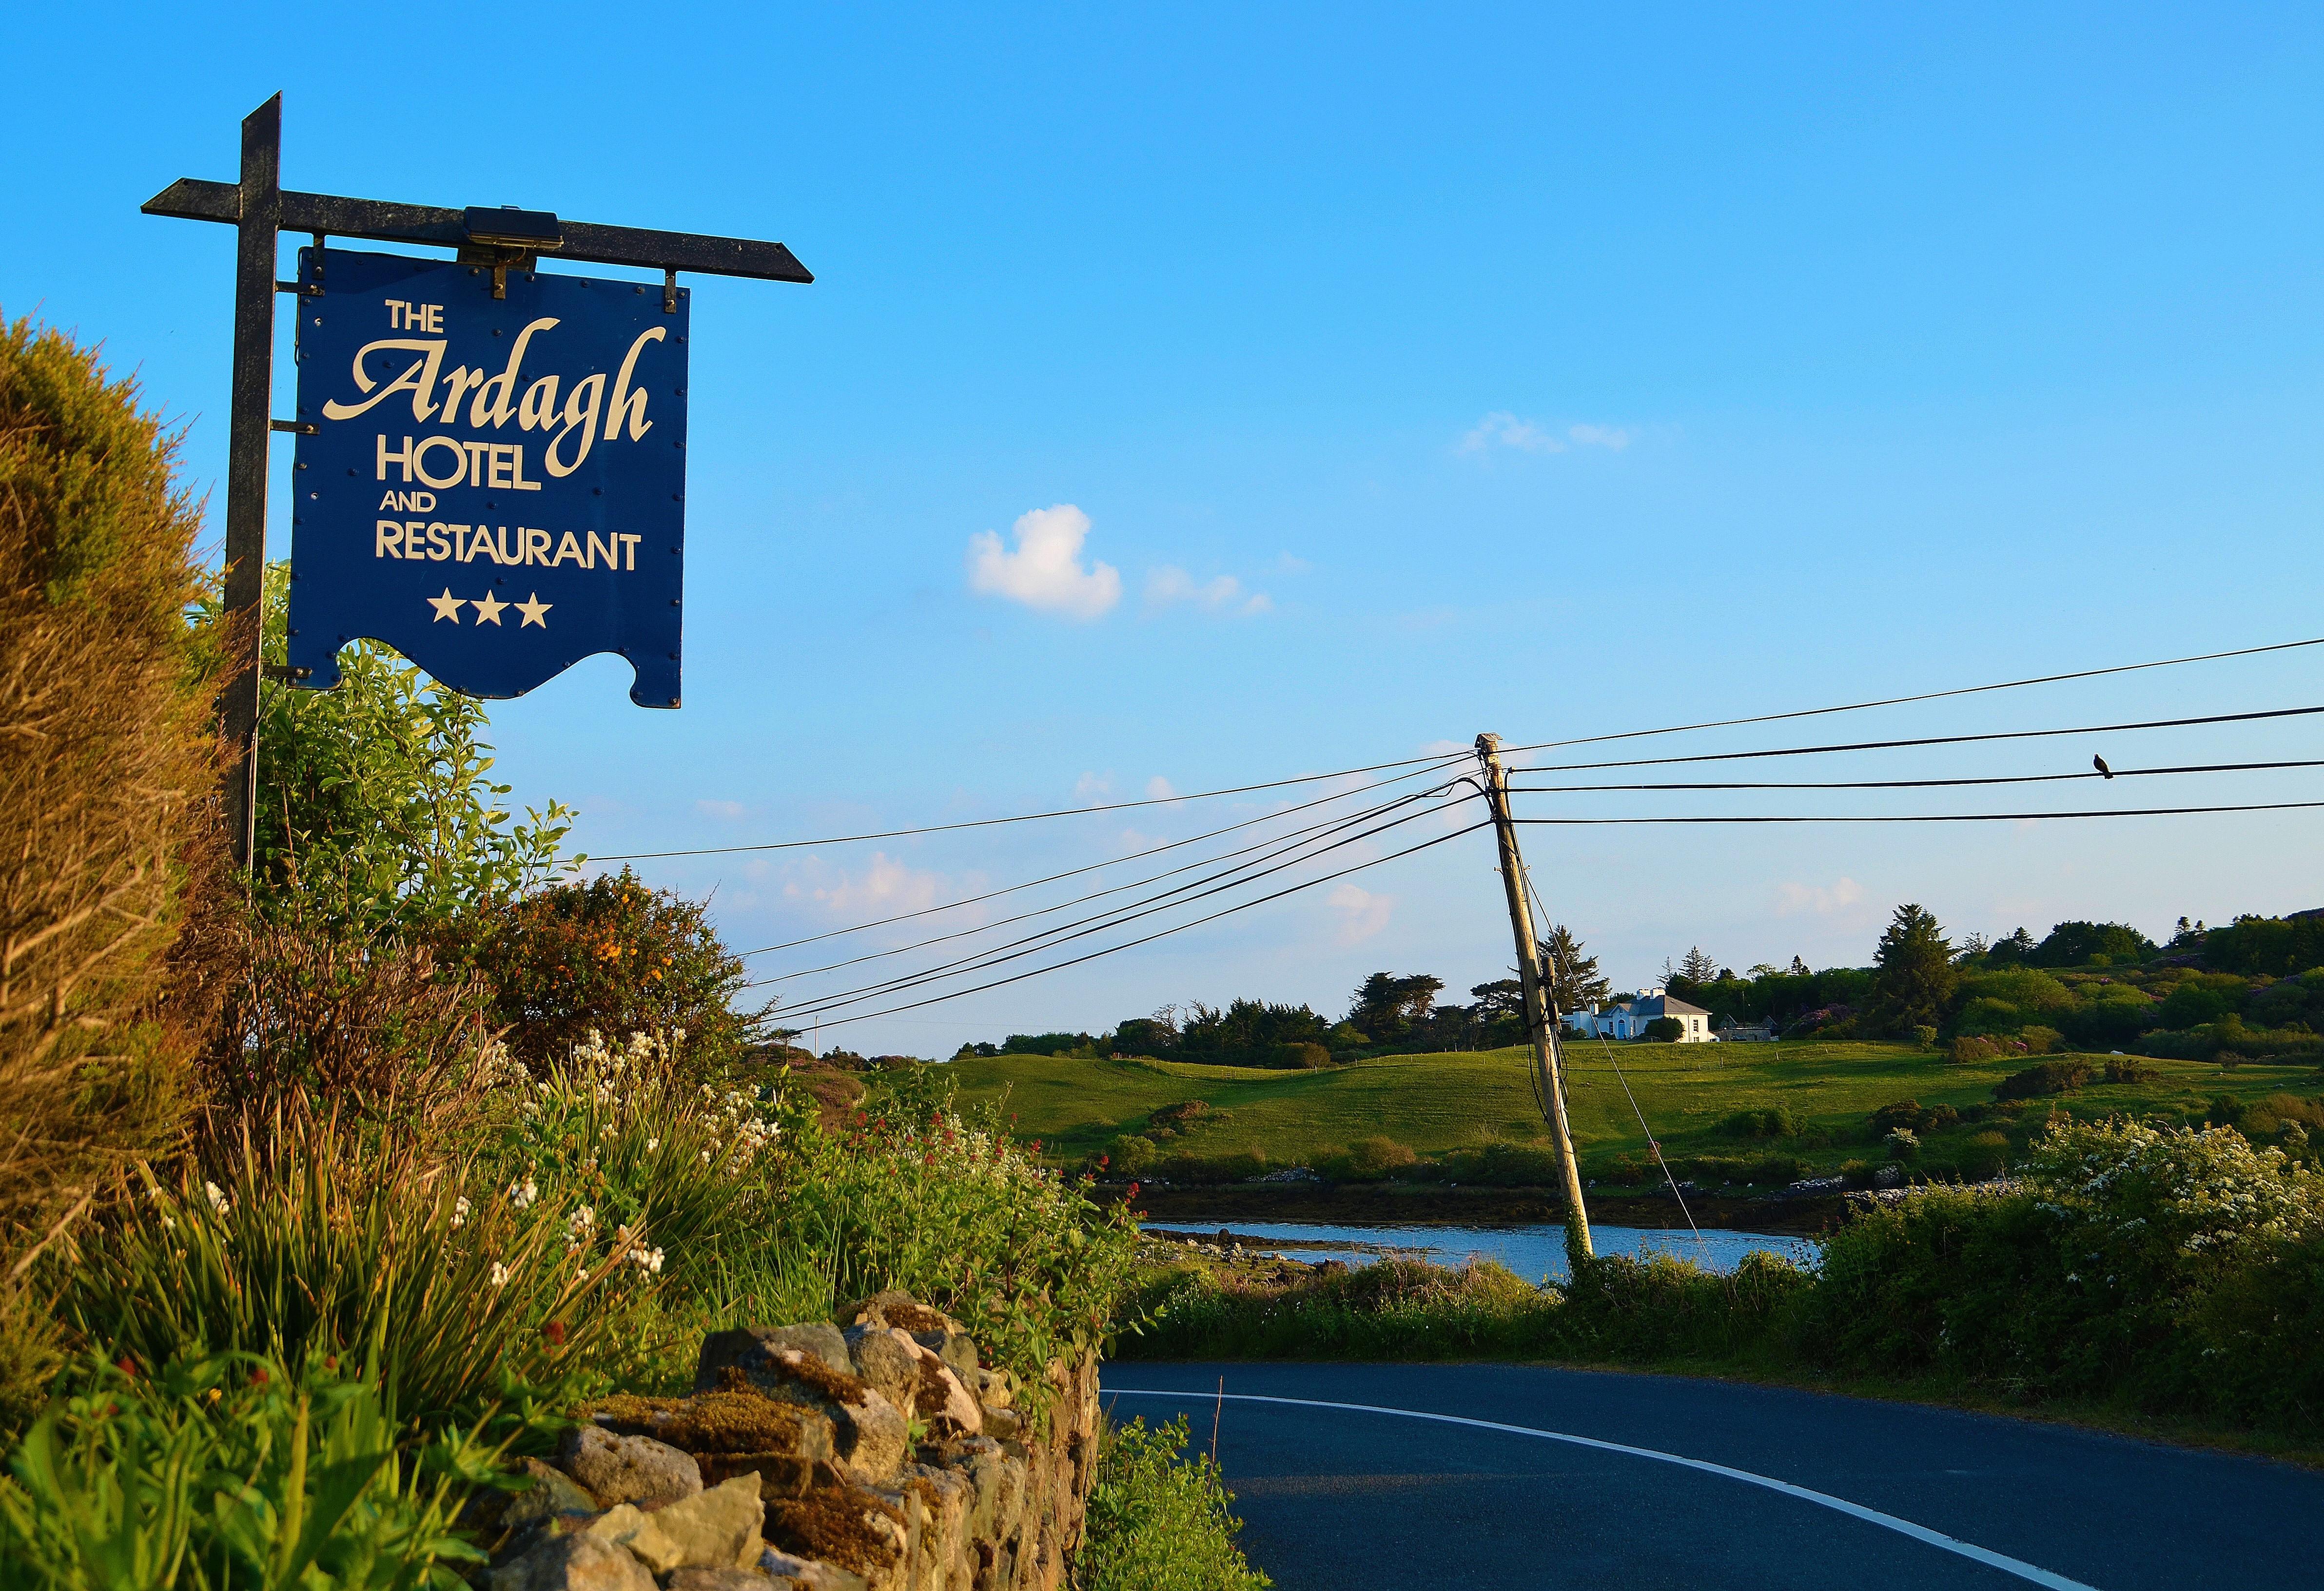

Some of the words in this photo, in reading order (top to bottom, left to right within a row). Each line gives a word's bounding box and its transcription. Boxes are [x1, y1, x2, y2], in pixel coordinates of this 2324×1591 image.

[384, 299, 445, 333] THE
[322, 317, 667, 478] Ardagh
[376, 434, 542, 490] HOTEL
[378, 490, 437, 513] AND
[375, 520, 642, 571] RESTAURANT
